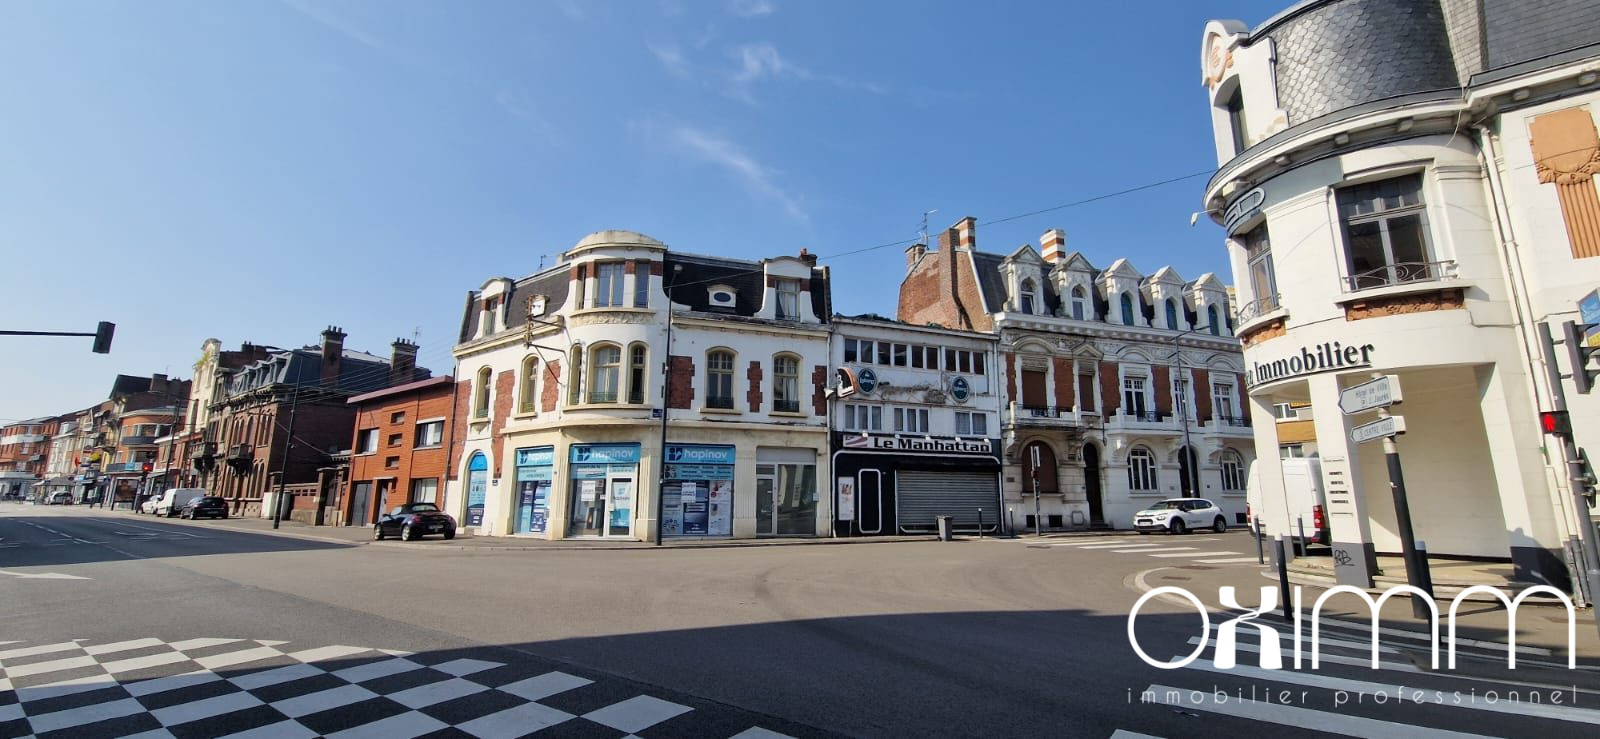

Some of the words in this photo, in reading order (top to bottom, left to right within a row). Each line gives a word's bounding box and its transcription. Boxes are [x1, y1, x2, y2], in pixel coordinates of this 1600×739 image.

[1254, 341, 1375, 382] Immobilier
[874, 437, 894, 449] Le
[898, 438, 991, 453] Manhattan
[591, 448, 634, 459] hapinov
[684, 449, 727, 460] hapinov
